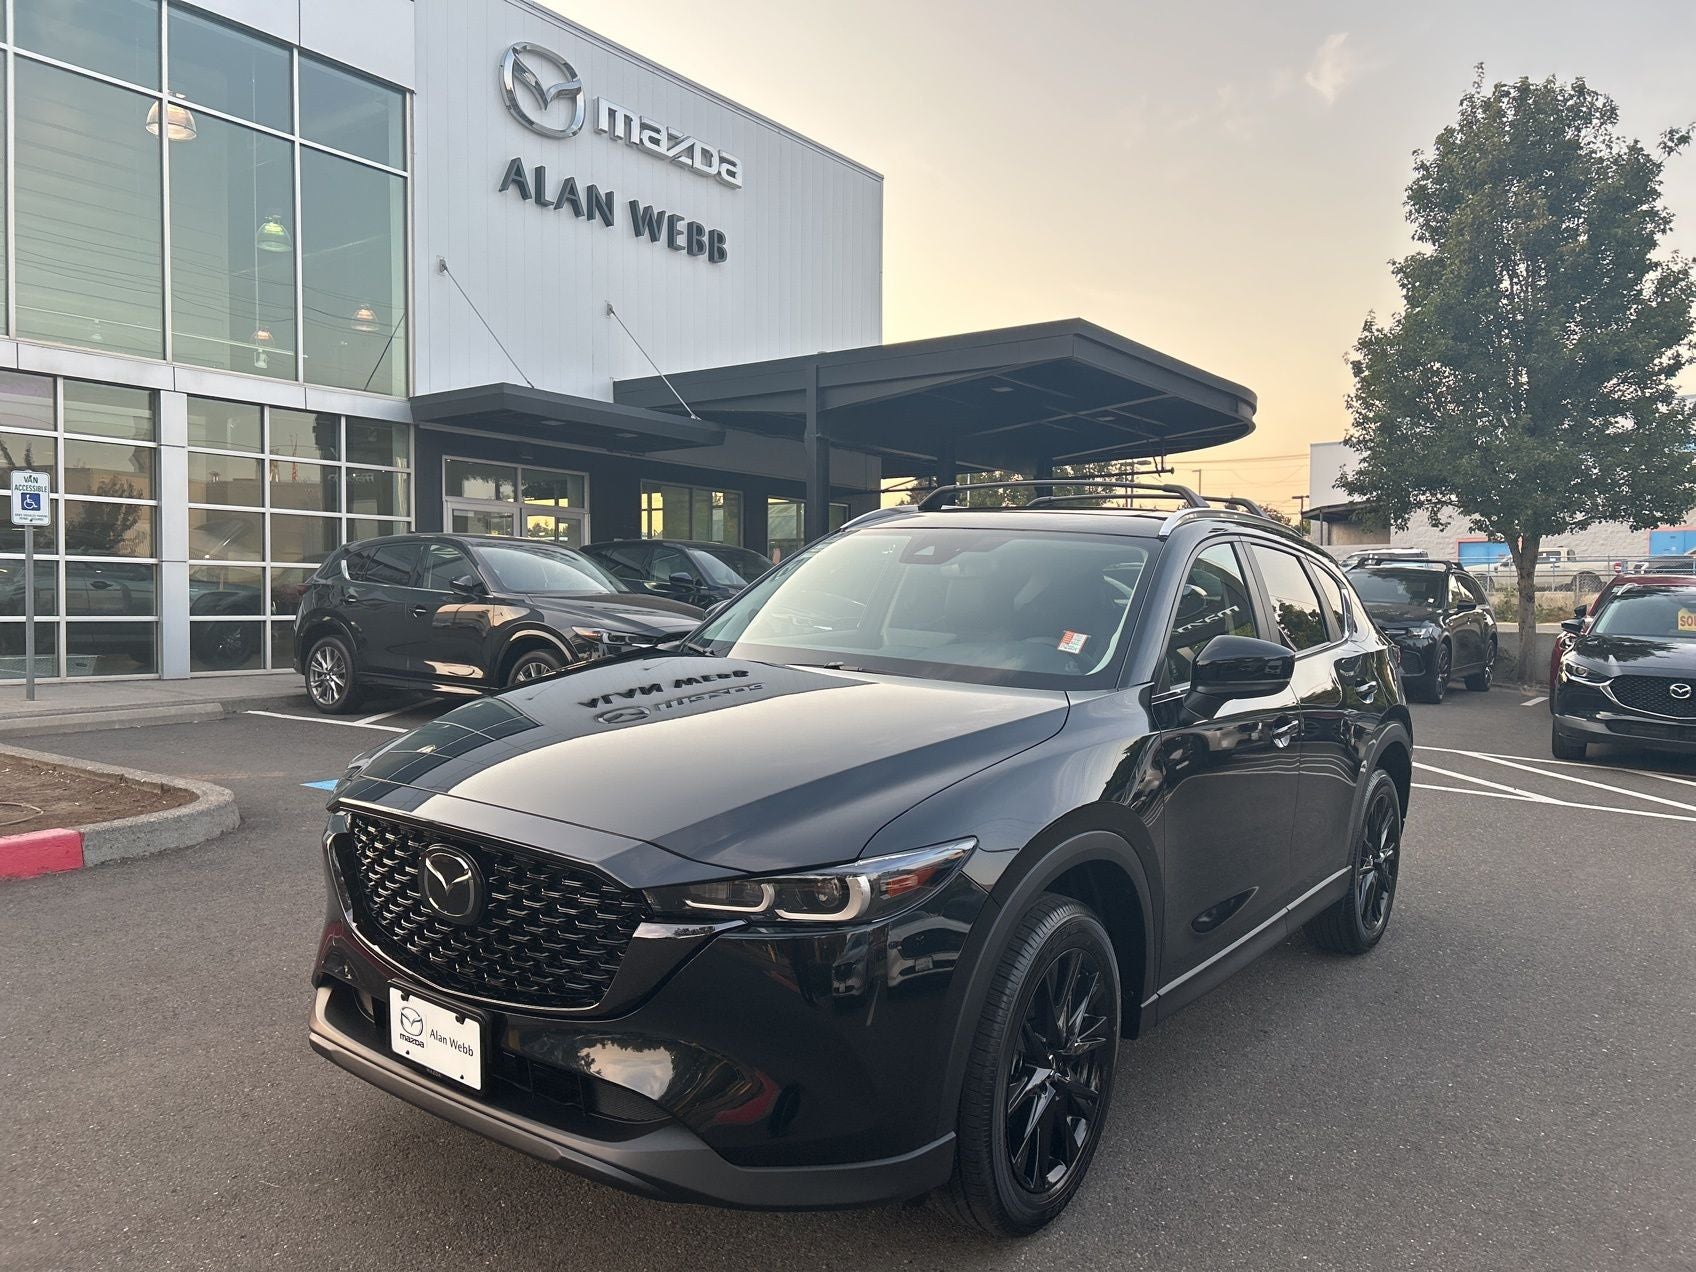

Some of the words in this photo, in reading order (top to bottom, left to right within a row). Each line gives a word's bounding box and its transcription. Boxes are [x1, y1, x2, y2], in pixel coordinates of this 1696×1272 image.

[498, 157, 615, 228] ALAN
[628, 199, 728, 264] WEBB
[14, 484, 48, 493] ACCESSIBLE
[23, 475, 39, 484] VAN
[429, 1028, 448, 1045] Alan
[449, 1037, 474, 1057] Webb
